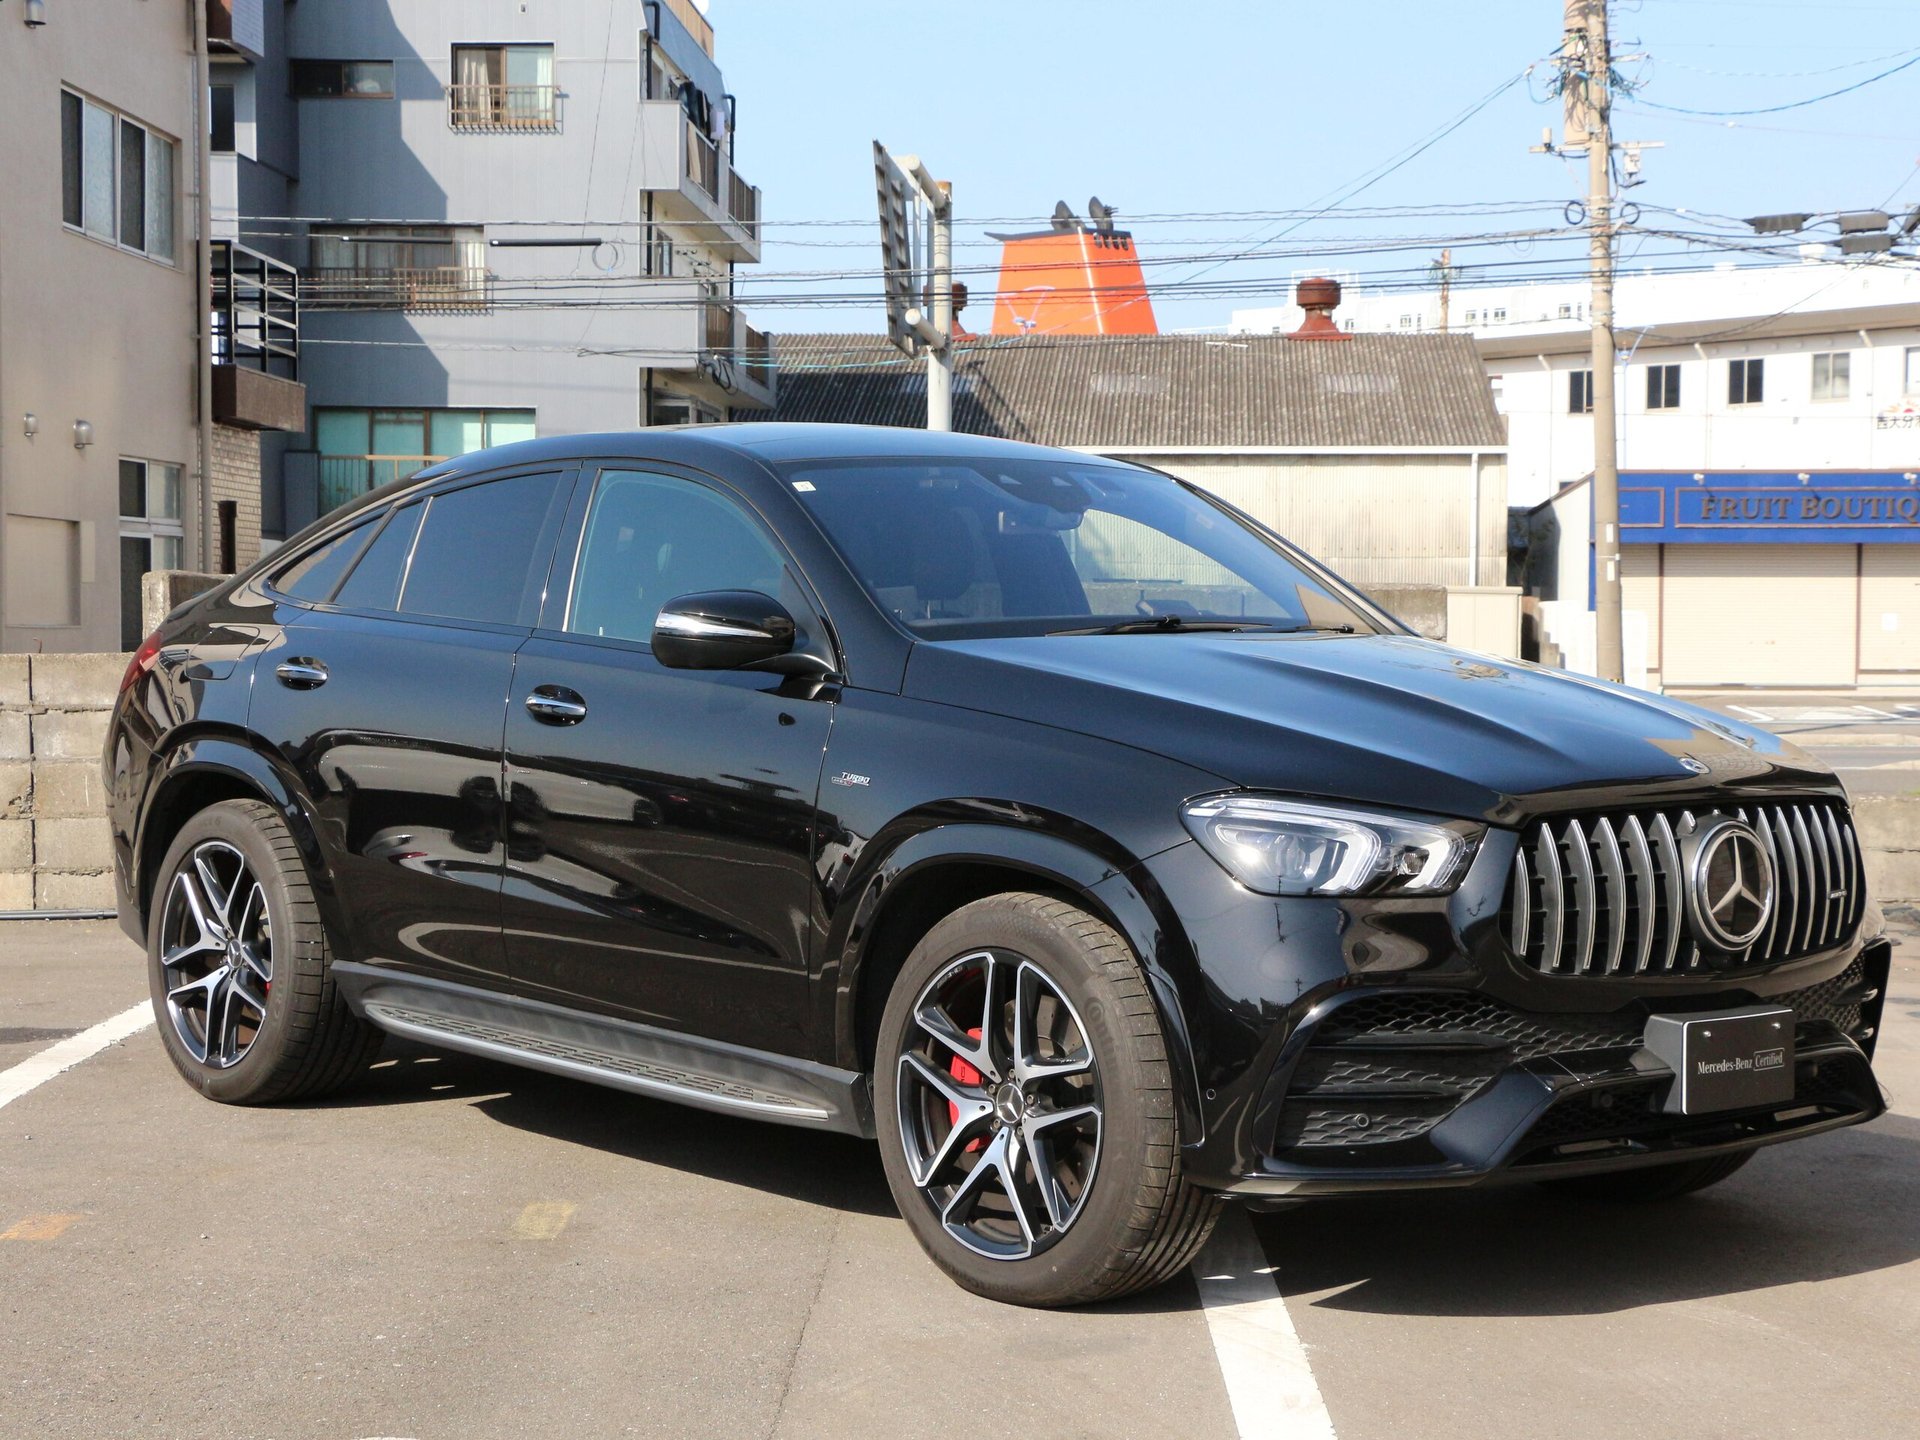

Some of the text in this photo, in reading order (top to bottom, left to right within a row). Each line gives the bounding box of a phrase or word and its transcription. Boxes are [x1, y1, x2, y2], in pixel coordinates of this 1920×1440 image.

[1701, 496, 1920, 524] FRUIT BOUTIQ
[842, 771, 870, 785] TURBO
[1697, 1051, 1783, 1075] Mercedes-Benz Certified
